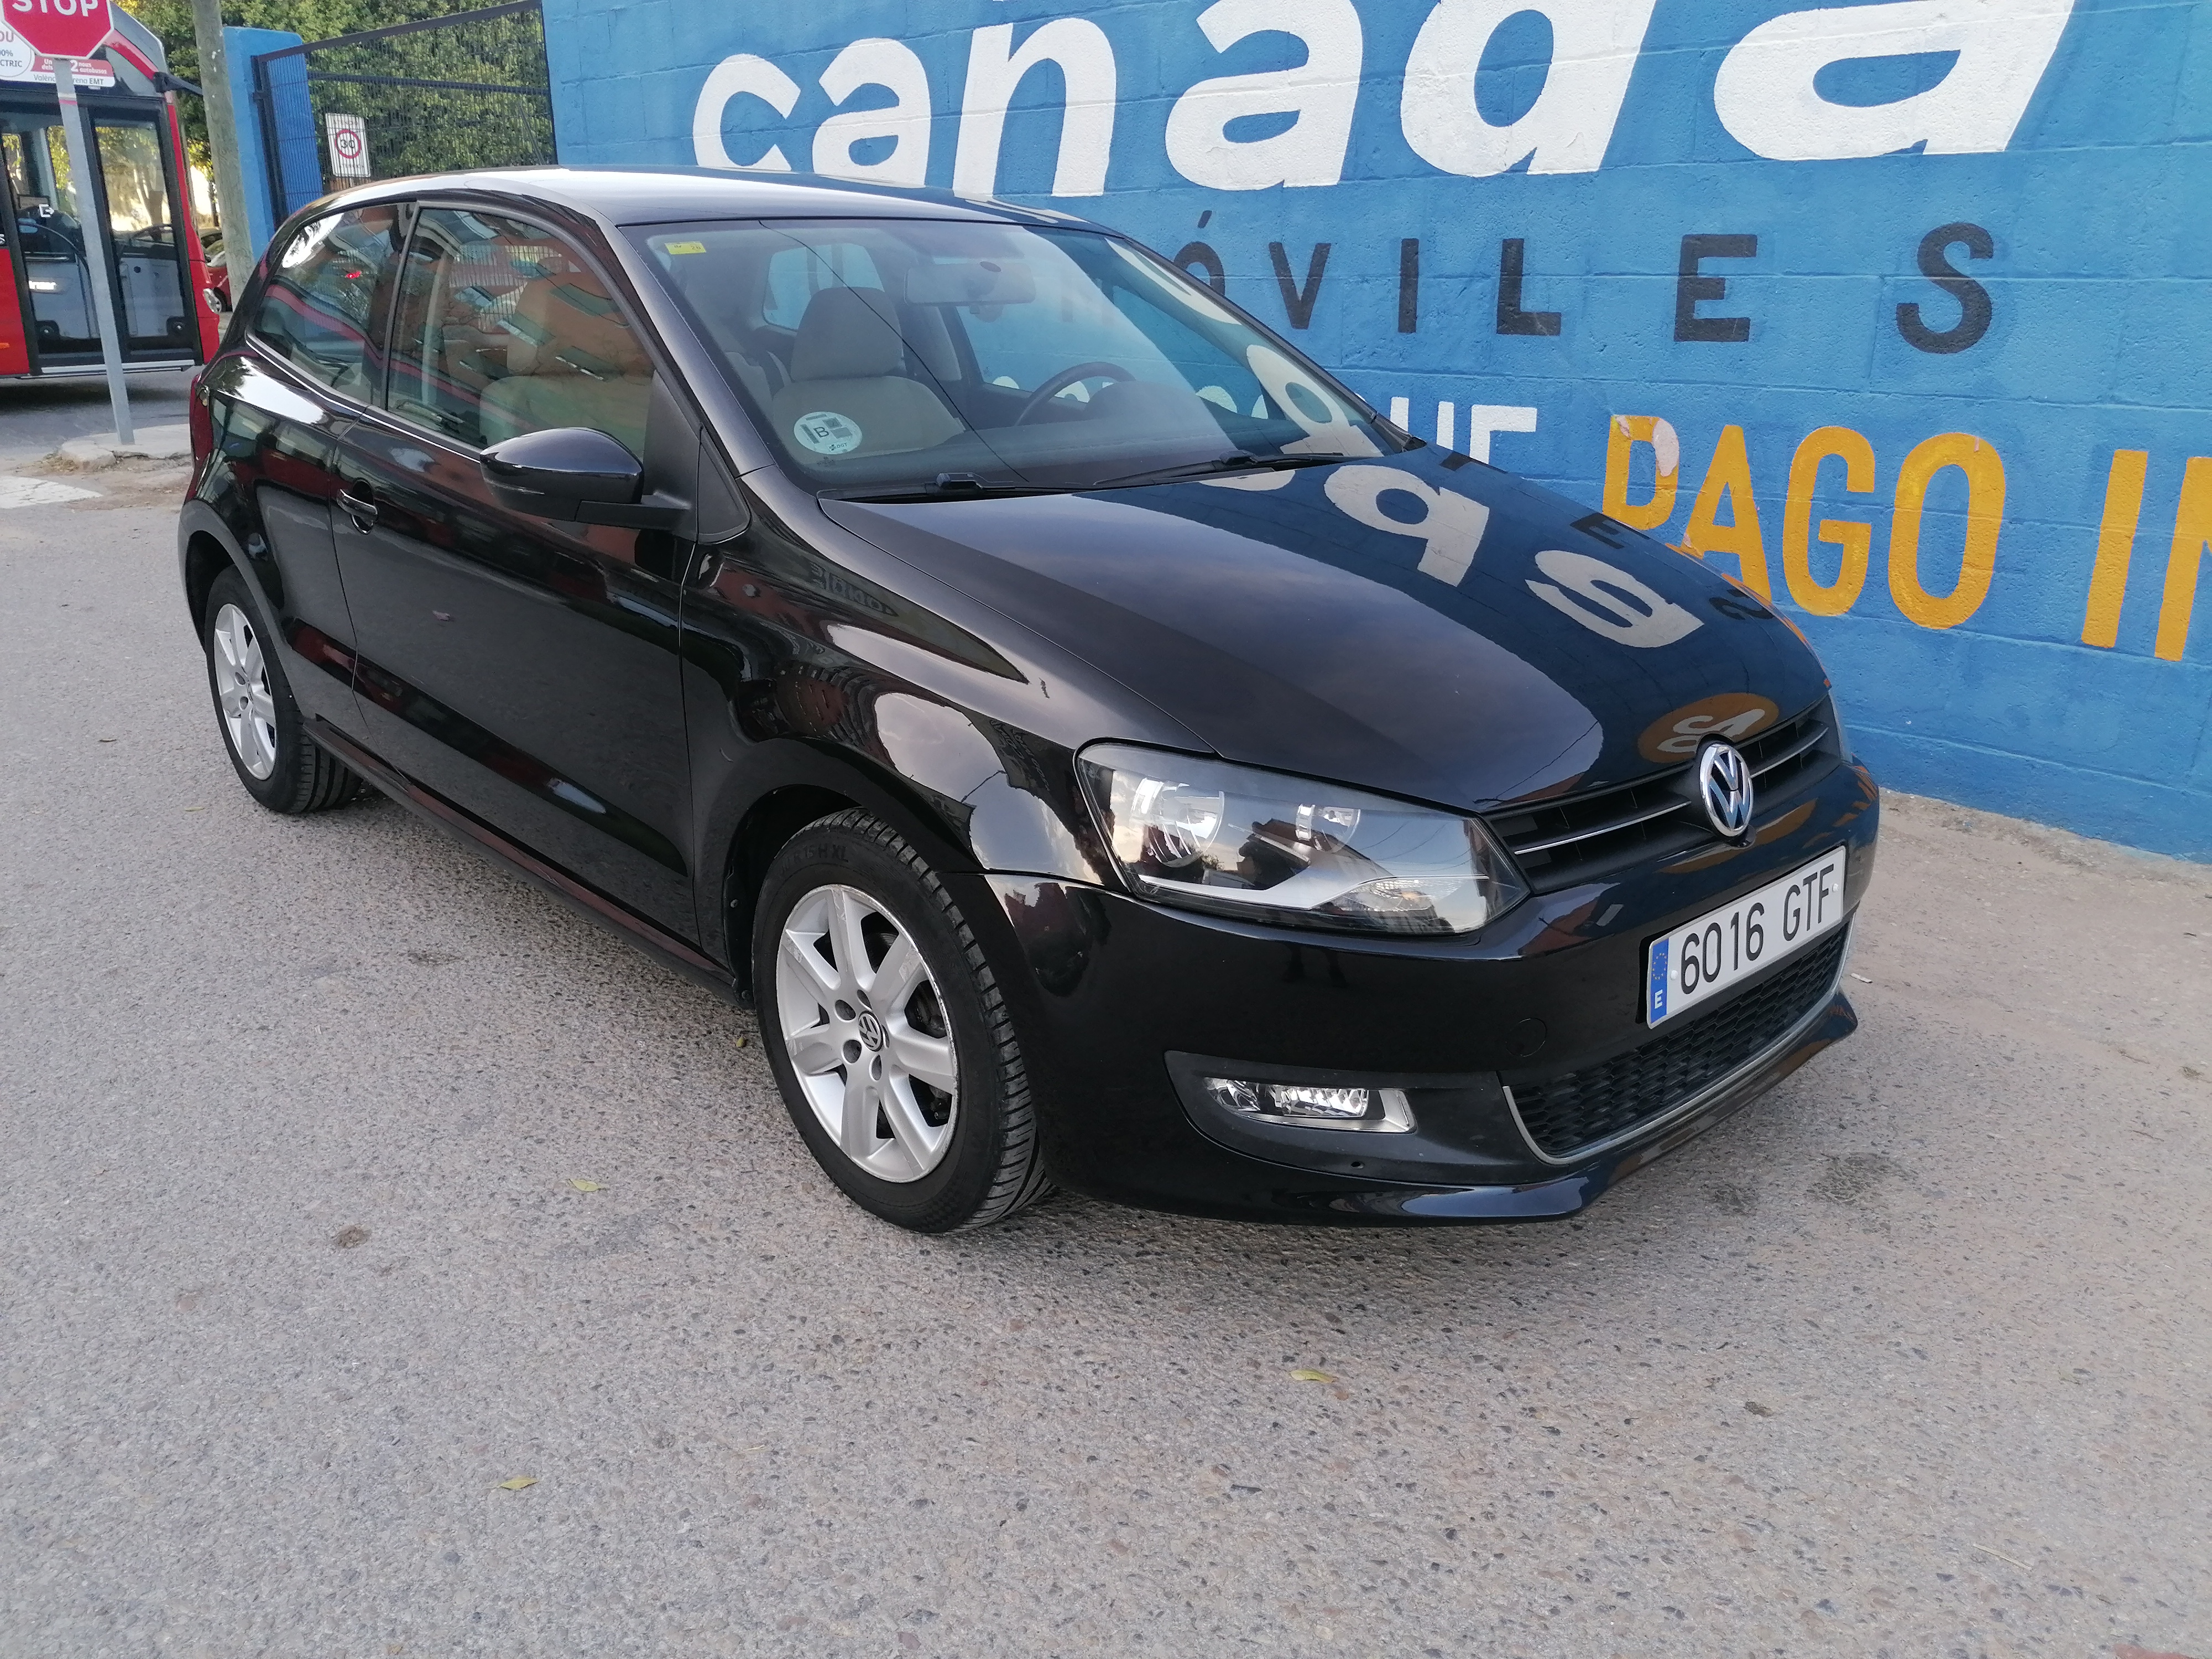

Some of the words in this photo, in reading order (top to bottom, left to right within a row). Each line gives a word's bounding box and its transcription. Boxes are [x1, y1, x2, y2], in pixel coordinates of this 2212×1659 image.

[0, 59, 23, 67] CTRIC
[70, 59, 79, 72] 2
[813, 426, 830, 438] B
[1681, 902, 1765, 995] 6016
[1783, 863, 1834, 941] GTF
[1654, 989, 1663, 1009] E
